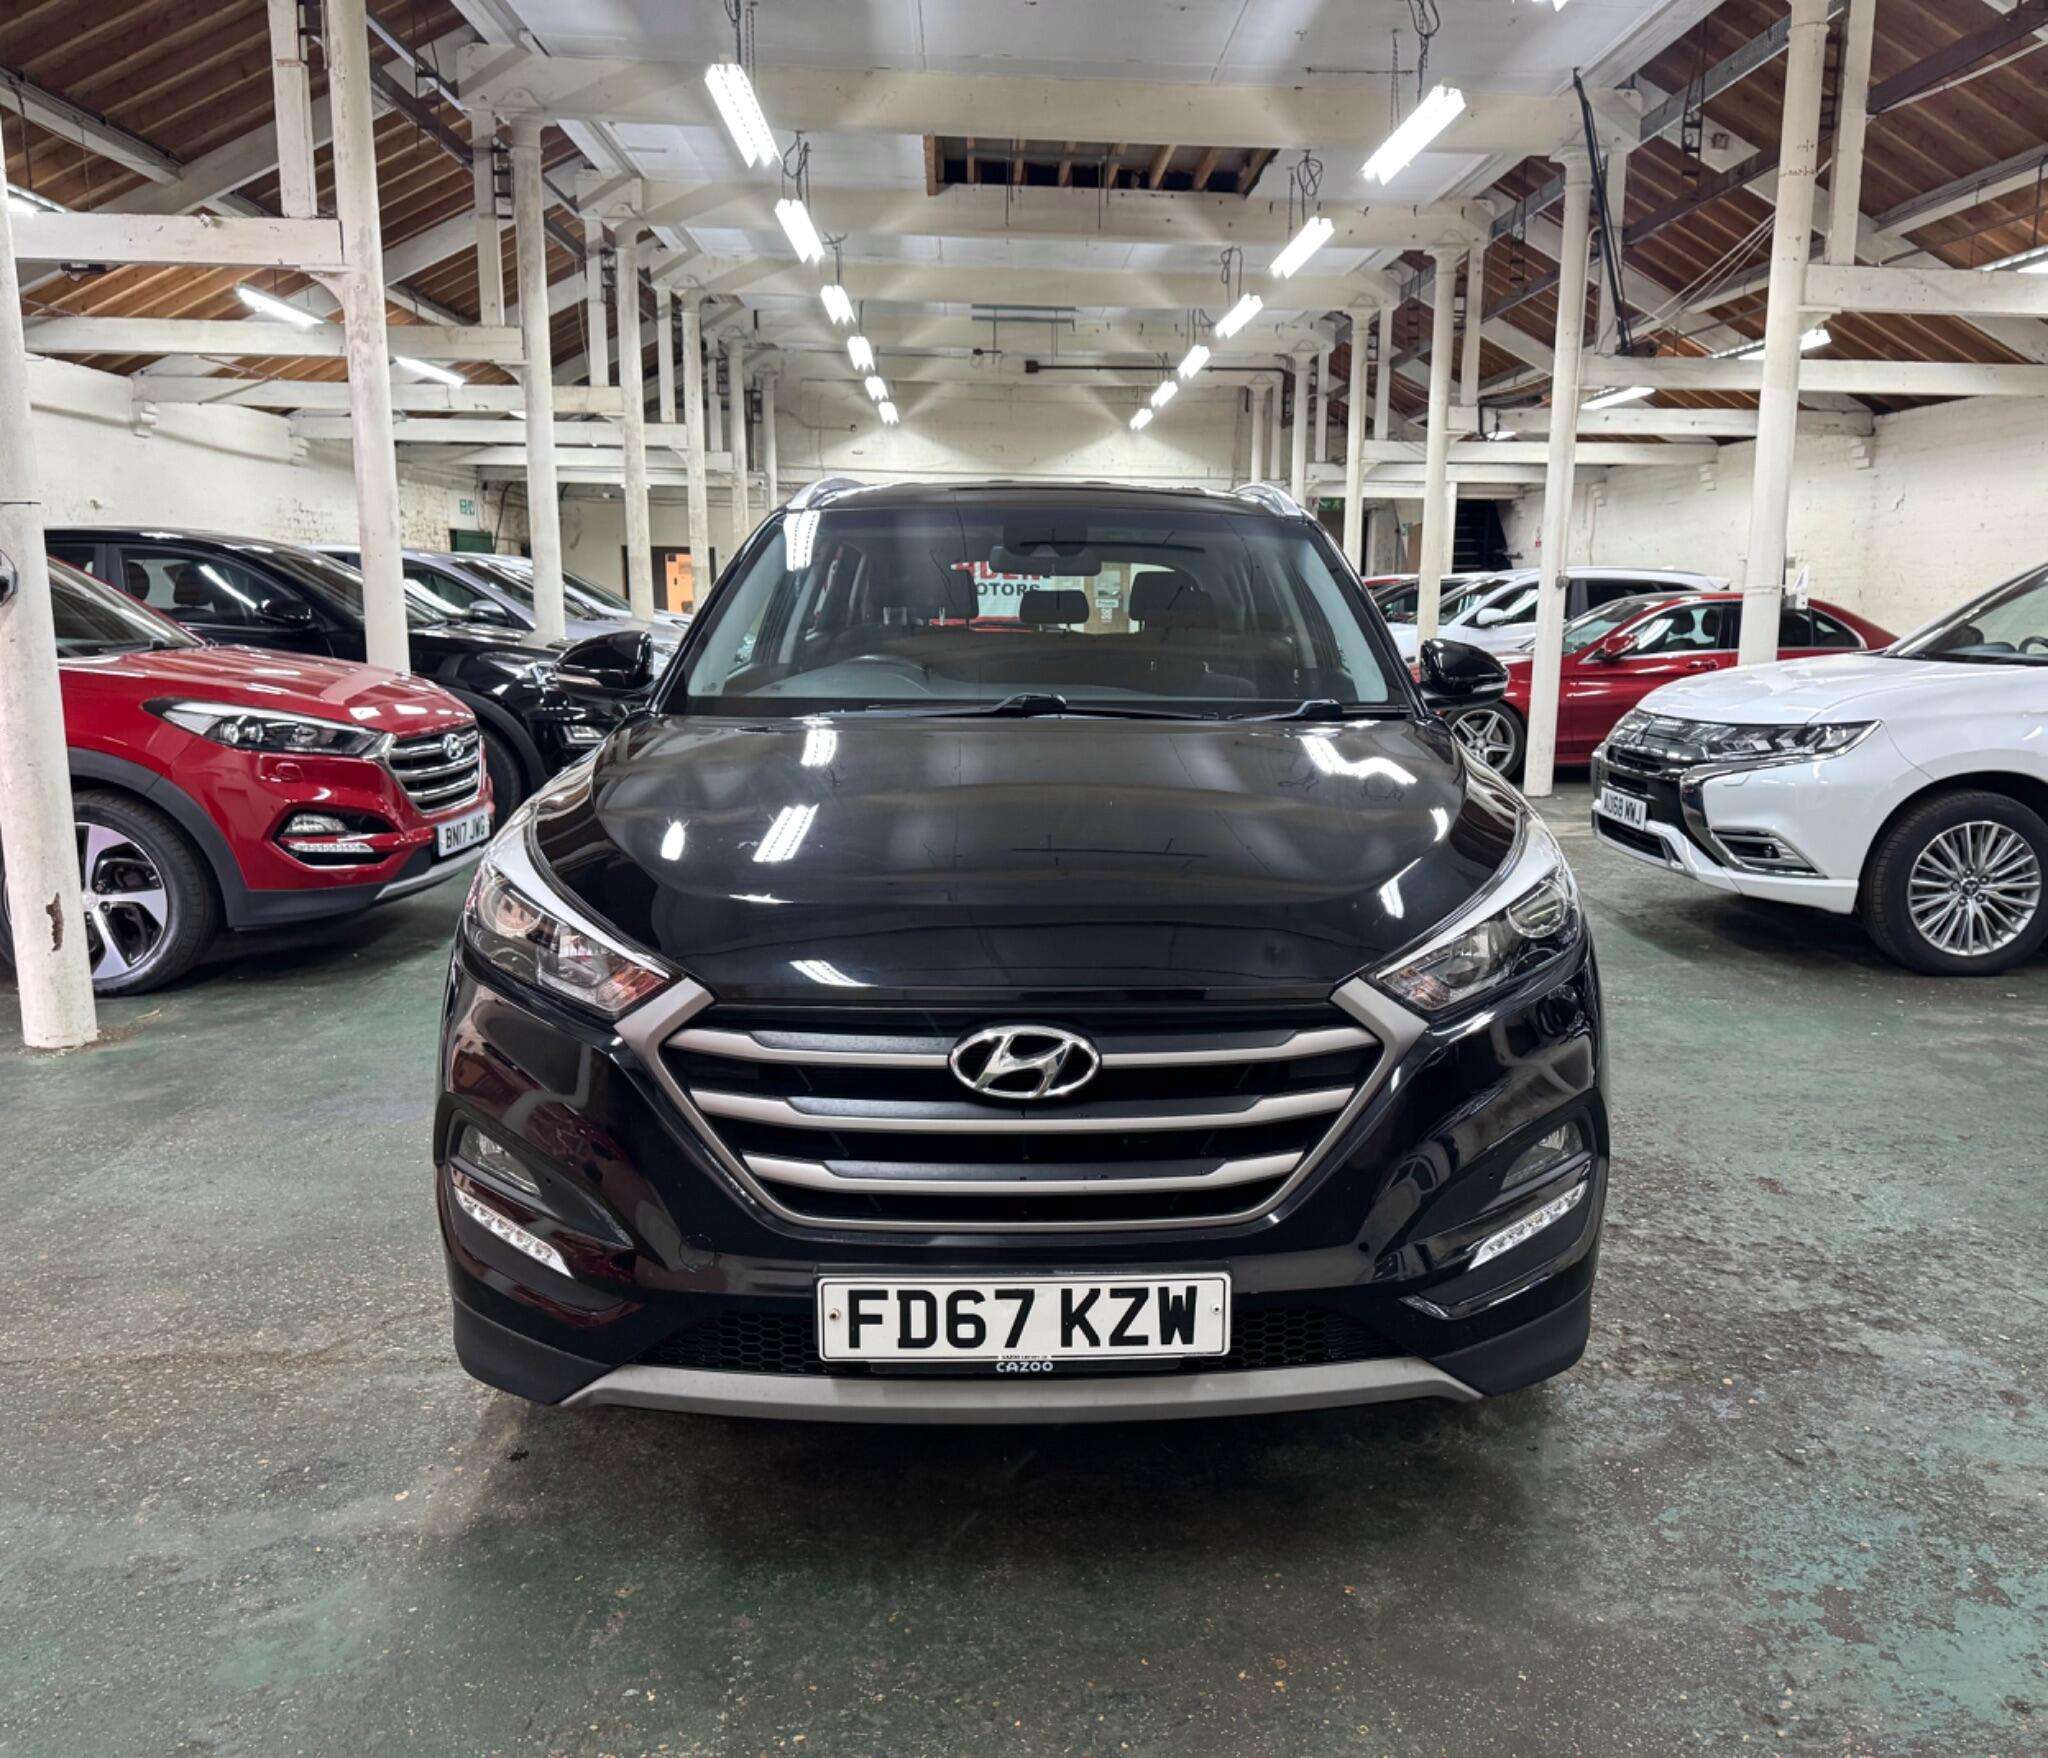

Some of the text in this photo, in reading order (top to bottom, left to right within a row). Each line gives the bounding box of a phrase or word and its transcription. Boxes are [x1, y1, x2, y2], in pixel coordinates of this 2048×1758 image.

[446, 822, 467, 849] BN17
[848, 1285, 1198, 1349] FD67 KZW
[996, 1361, 1054, 1373] CAZOO
